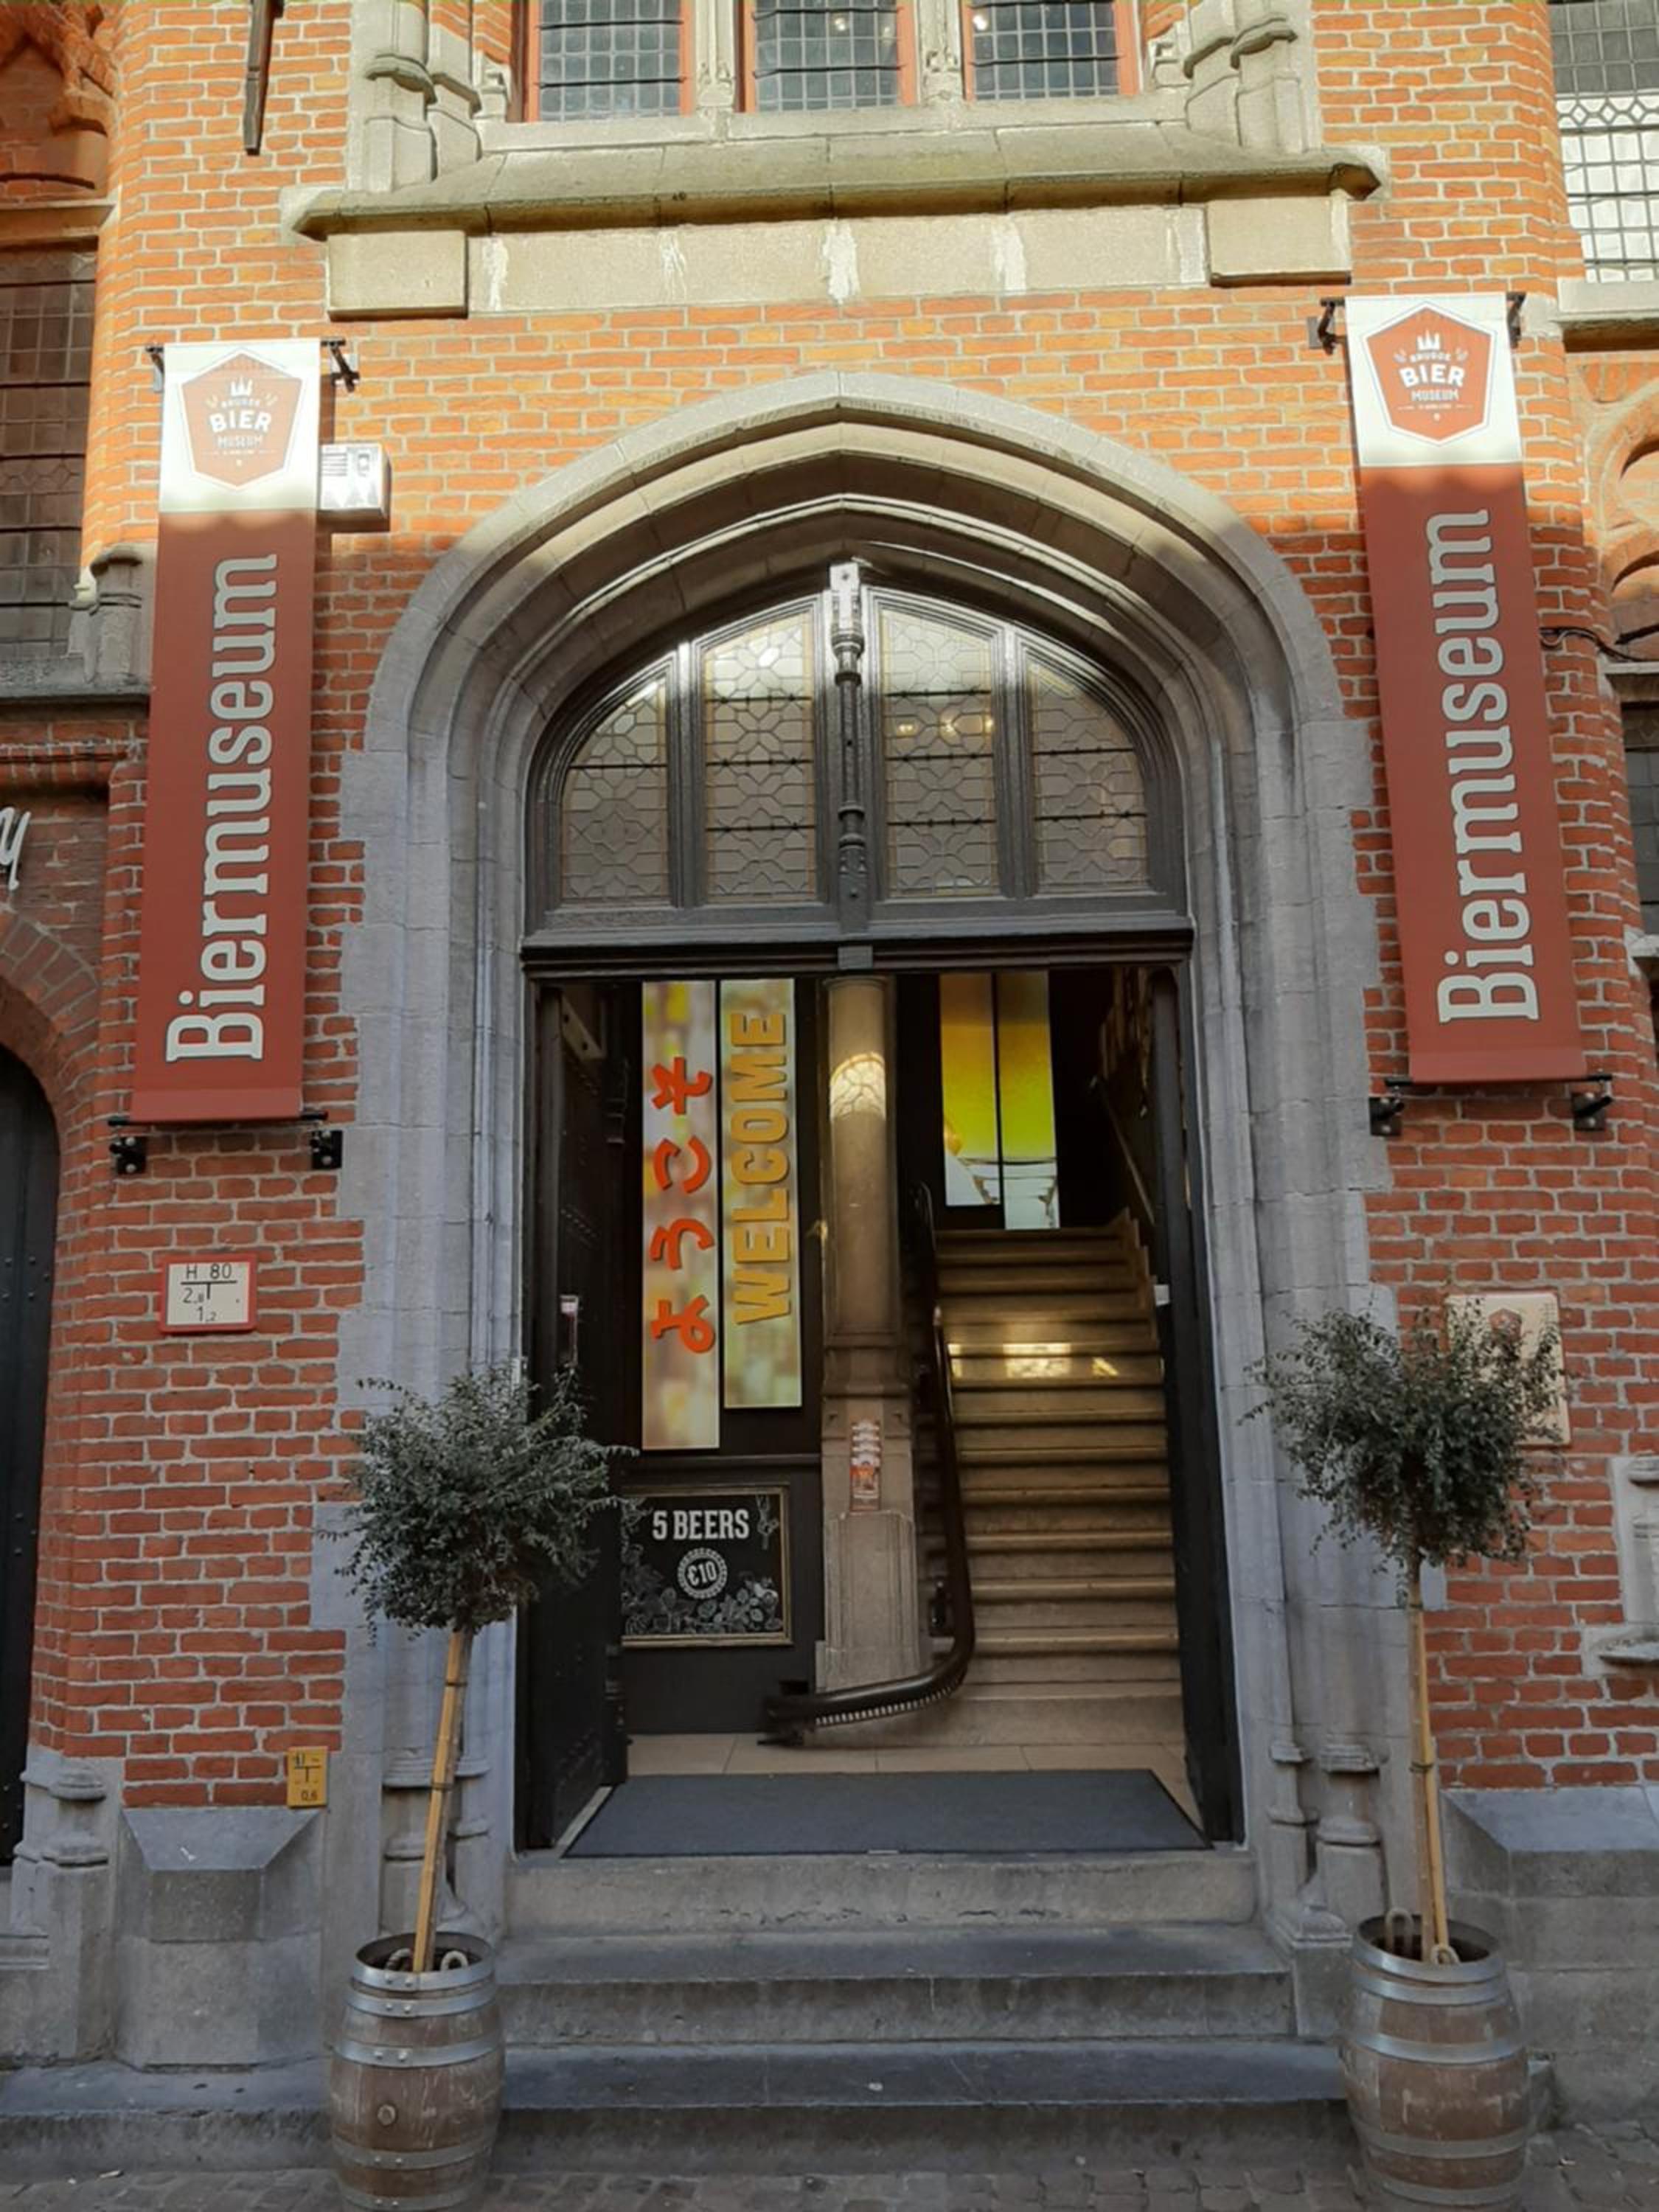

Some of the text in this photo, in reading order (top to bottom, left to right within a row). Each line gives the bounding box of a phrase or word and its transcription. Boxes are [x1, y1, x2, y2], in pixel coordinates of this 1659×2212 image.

[1399, 364, 1465, 387] BIER
[1411, 389, 1459, 401] MUSEUM
[209, 410, 271, 433] BIER
[1425, 509, 1539, 1023] Biermuseum
[166, 554, 277, 1062] Biermuseum
[731, 1013, 790, 1324] WELCOME
[650, 1056, 715, 1354] ようこそ
[187, 1263, 232, 1279] H 80
[653, 1509, 749, 1540] 5 BEERS
[686, 1561, 717, 1587] €10
